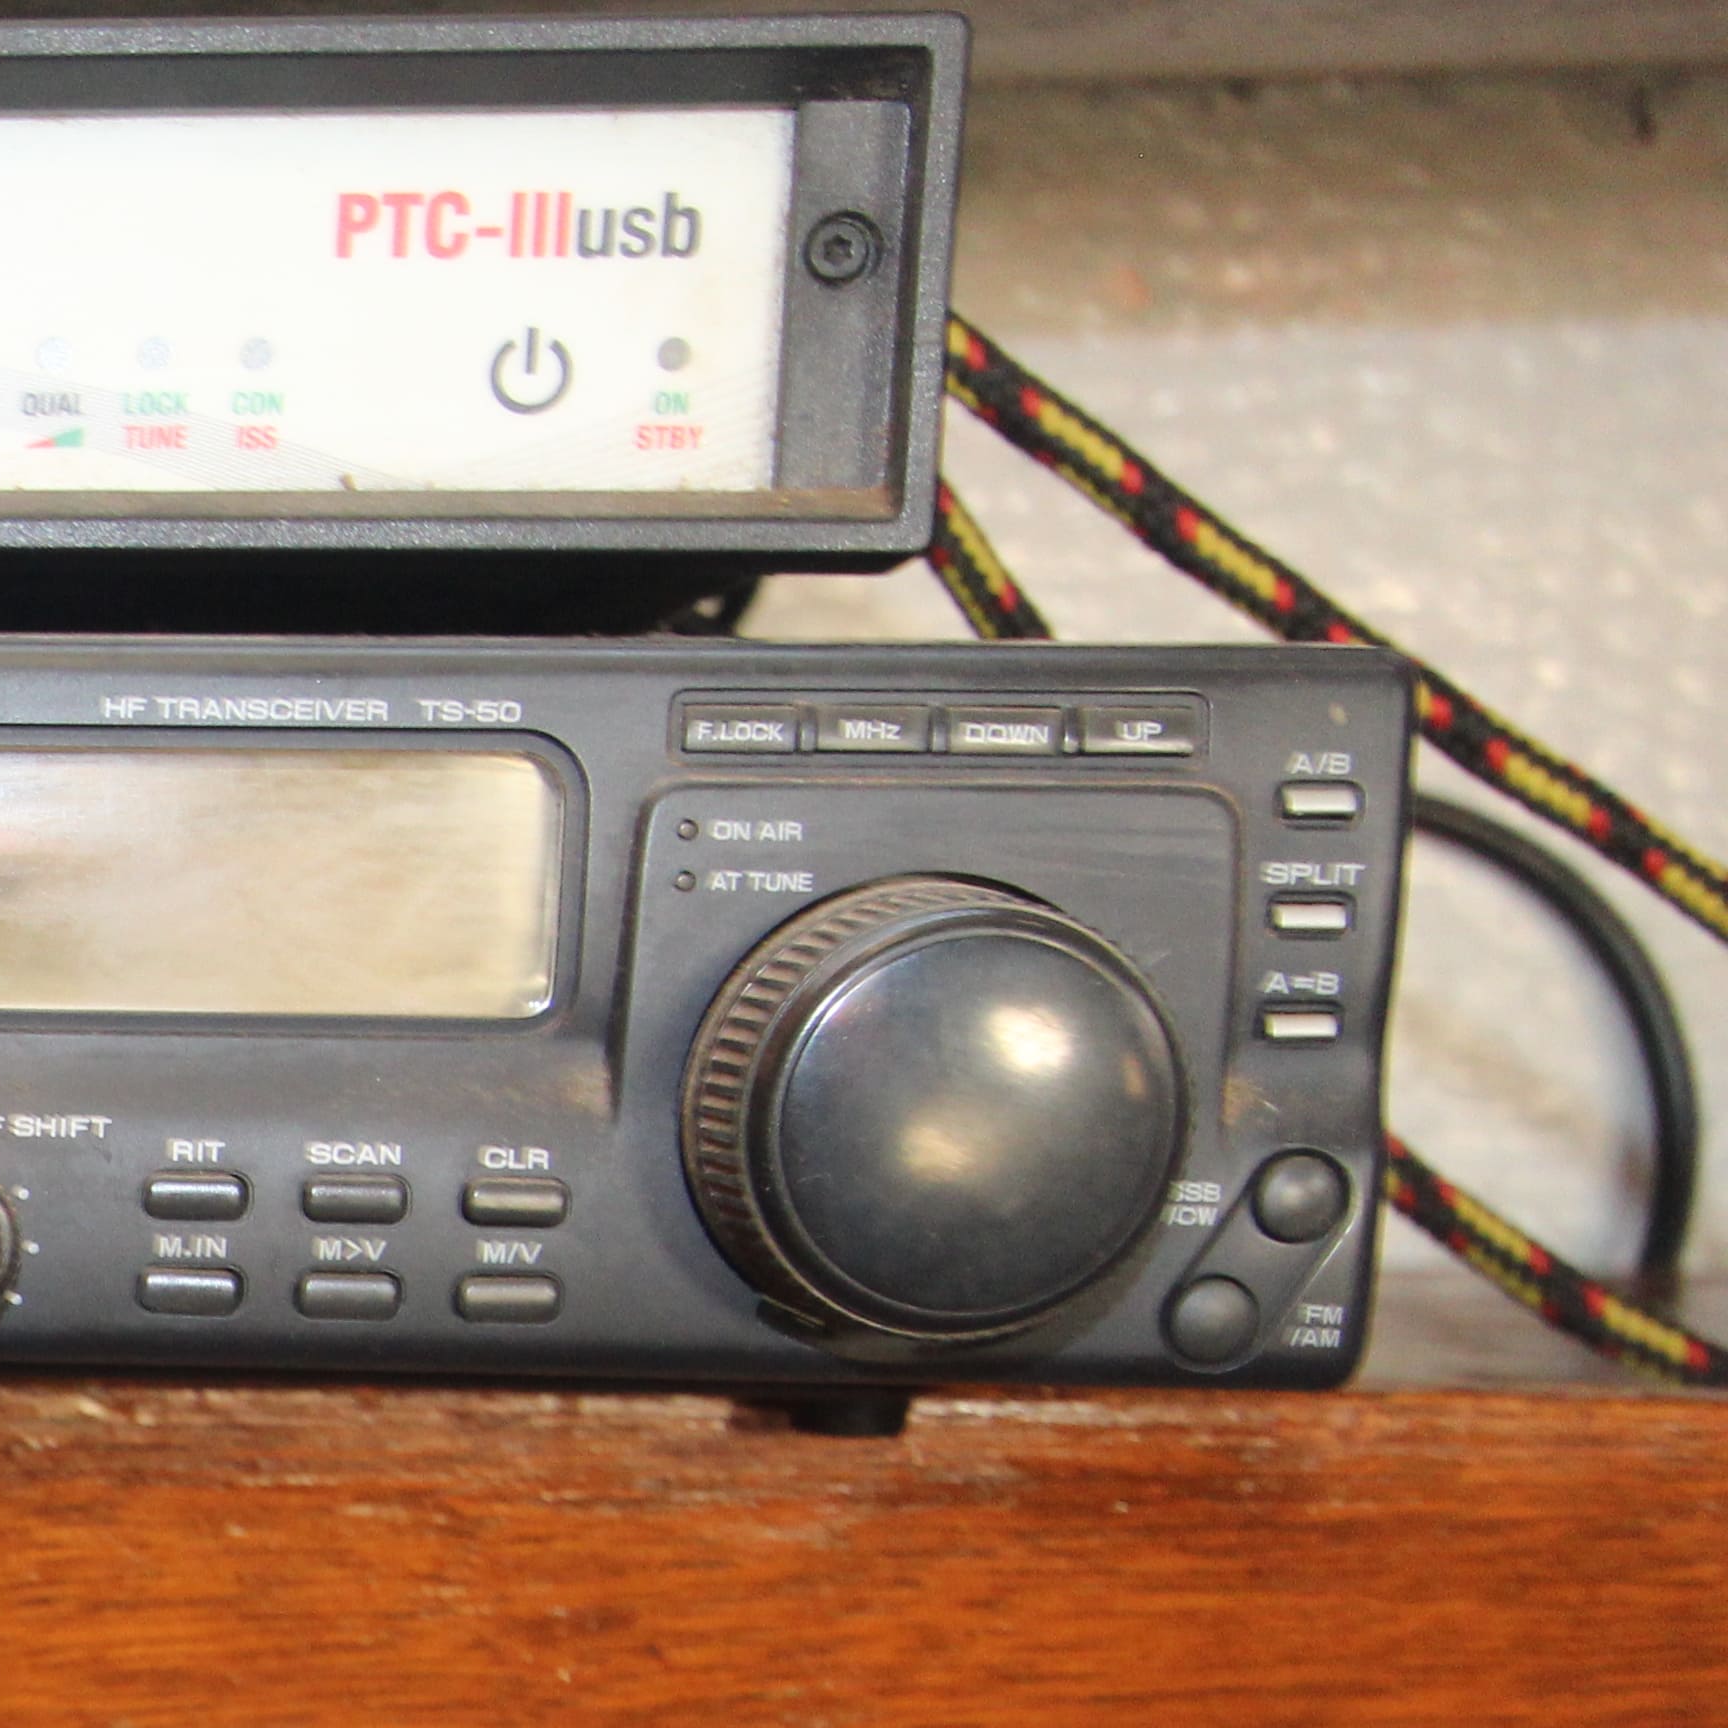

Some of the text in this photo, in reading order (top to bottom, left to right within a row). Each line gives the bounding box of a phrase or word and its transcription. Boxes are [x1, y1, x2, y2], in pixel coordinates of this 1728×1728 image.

[21, 392, 82, 416] QUAL
[122, 391, 189, 415] LOCK
[231, 391, 285, 415] CON
[652, 391, 691, 416] ON
[123, 425, 189, 450] TUNE
[236, 426, 278, 450] ISS
[636, 425, 703, 451] STBY
[103, 697, 522, 723] HF TRANSCEIVER TS-50
[697, 721, 784, 742] F.LOCK
[844, 719, 901, 742] MHz
[965, 722, 1049, 745] DOWN
[1121, 720, 1162, 742] UP
[1291, 751, 1352, 776] A/B
[713, 820, 804, 842] ON AIR
[711, 871, 814, 893] AT TUNE
[1262, 862, 1366, 888] SPLIT
[1260, 971, 1340, 997] A=B
[13, 1114, 112, 1139] SHIFT
[167, 1140, 226, 1163] RIT
[307, 1142, 402, 1167] SCAN
[479, 1146, 550, 1171] CLR
[157, 1235, 228, 1259] M.IN
[478, 1240, 543, 1265] M/V
[1302, 1304, 1344, 1326] FM
[1288, 1327, 1342, 1349] /AM
